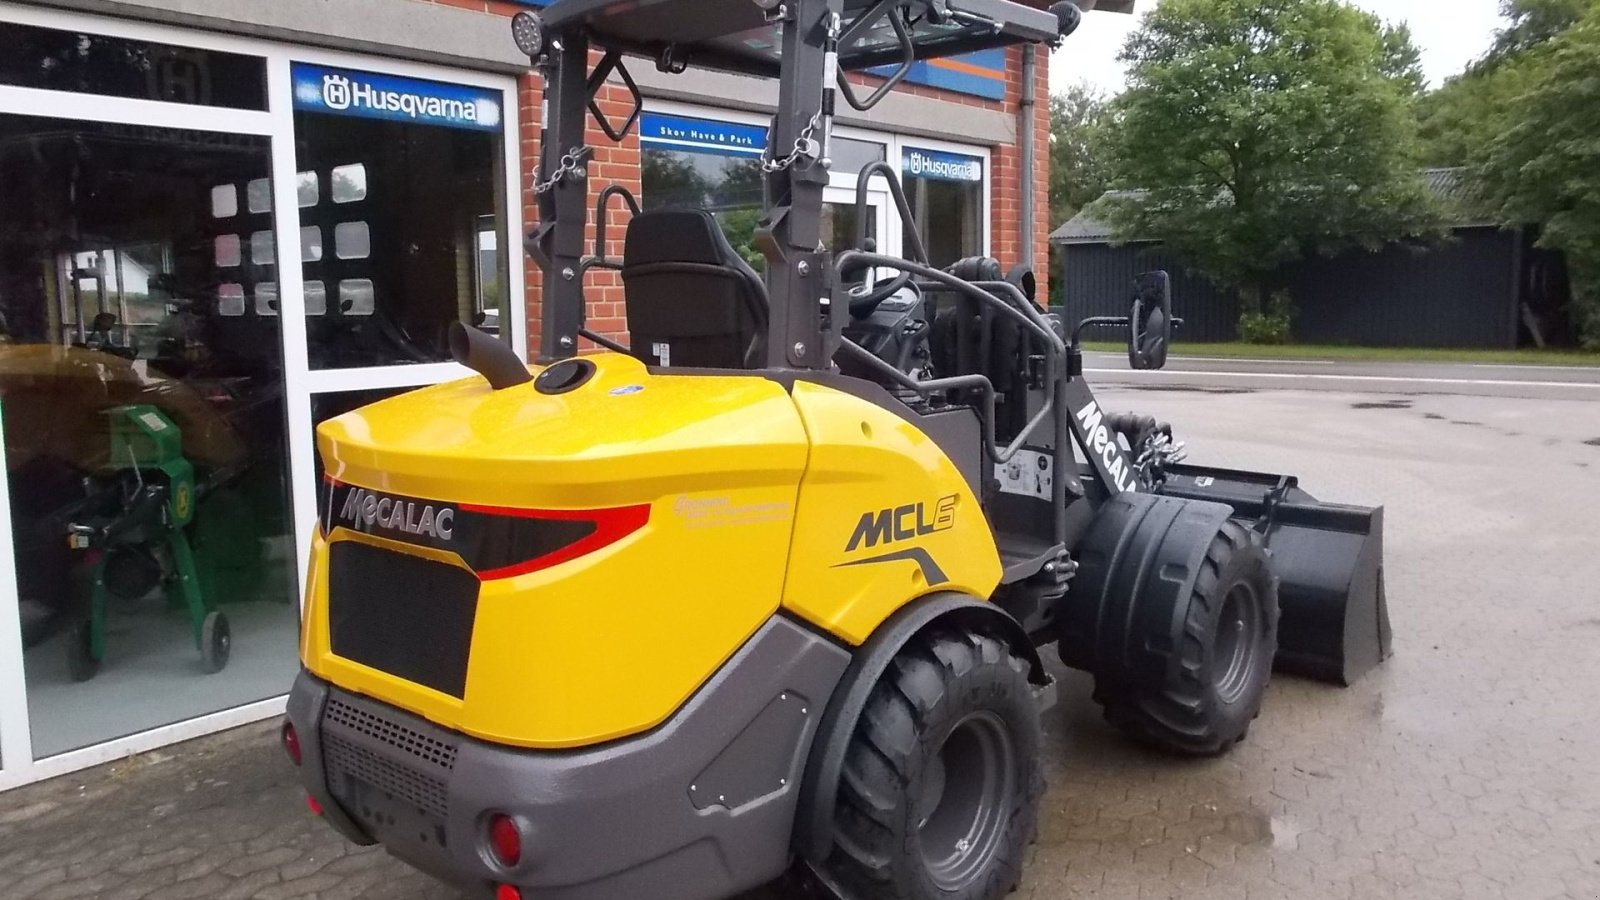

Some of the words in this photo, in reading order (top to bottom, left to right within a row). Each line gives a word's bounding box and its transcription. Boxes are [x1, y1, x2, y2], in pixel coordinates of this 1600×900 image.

[352, 82, 477, 120] Husqvarna
[660, 126, 686, 137] Skov
[691, 130, 716, 141] Have
[719, 133, 725, 142] &
[730, 135, 752, 145] Park
[922, 156, 972, 177] Husqvarna
[844, 494, 956, 552] MCL6
